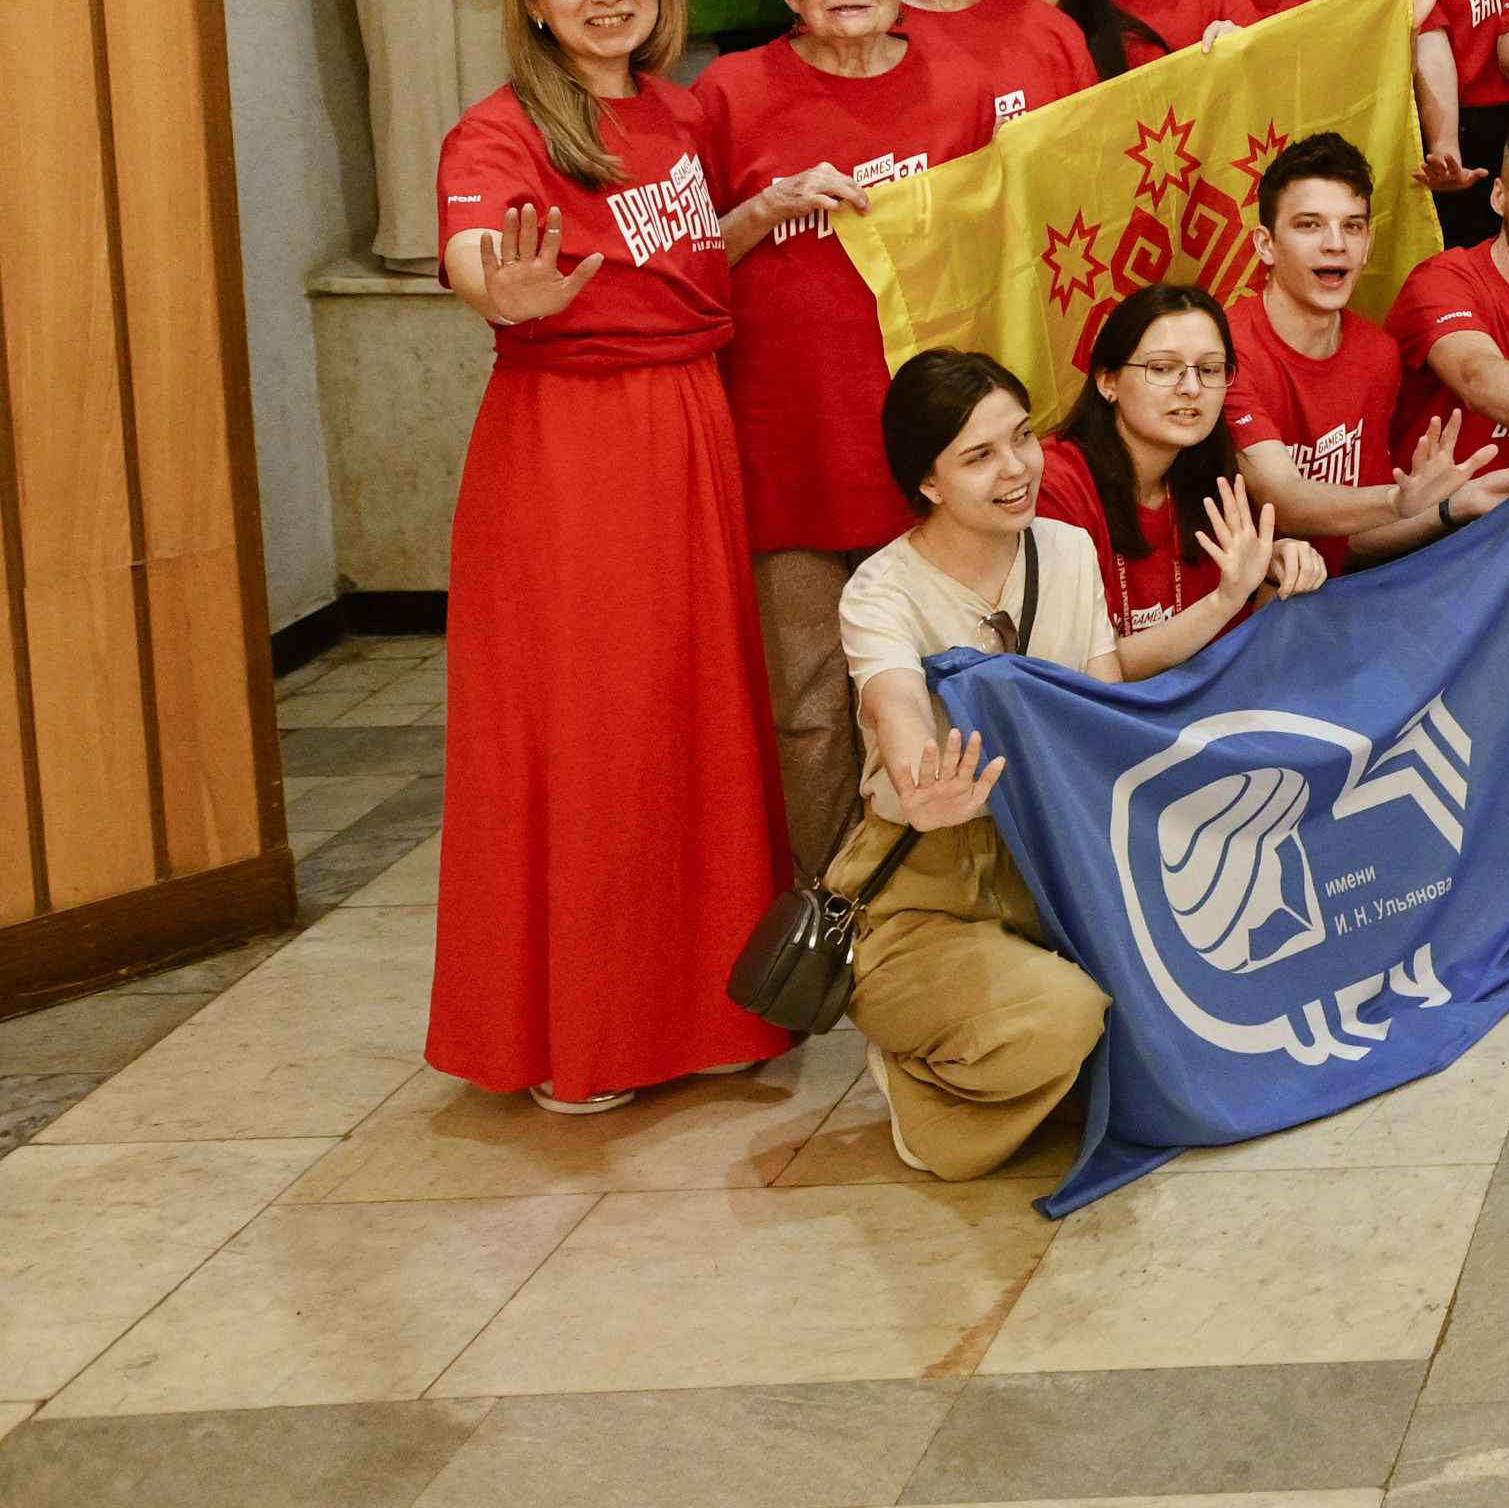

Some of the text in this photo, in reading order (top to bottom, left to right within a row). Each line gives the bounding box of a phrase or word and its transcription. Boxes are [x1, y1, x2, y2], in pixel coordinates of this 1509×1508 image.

[856, 158, 892, 183] GAMES
[1318, 428, 1345, 454] GAMES
[1324, 865, 1377, 898] имени
[1334, 876, 1454, 937] И. Н. Ульянова
